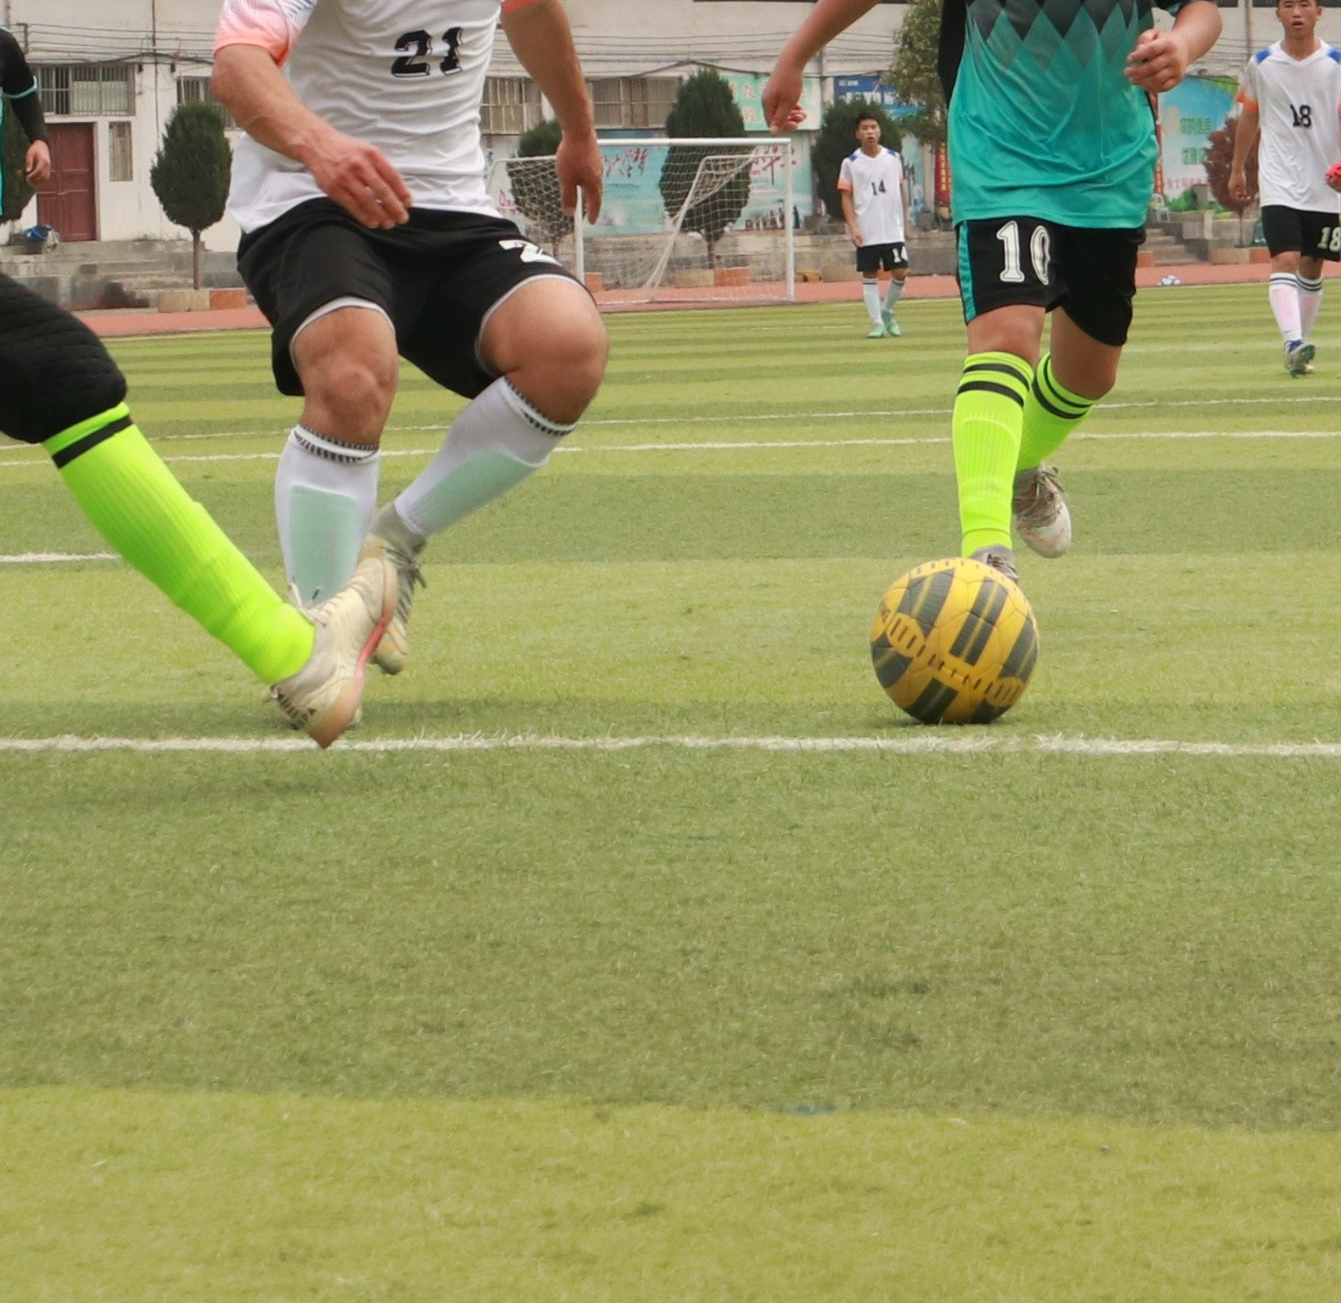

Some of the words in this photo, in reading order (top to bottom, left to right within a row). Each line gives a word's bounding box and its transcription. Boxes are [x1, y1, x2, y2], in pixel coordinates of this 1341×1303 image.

[391, 26, 463, 78] 21
[1290, 104, 1312, 128] 18
[871, 180, 886, 196] 14
[1317, 226, 1341, 252] 18
[996, 220, 1051, 286] 10
